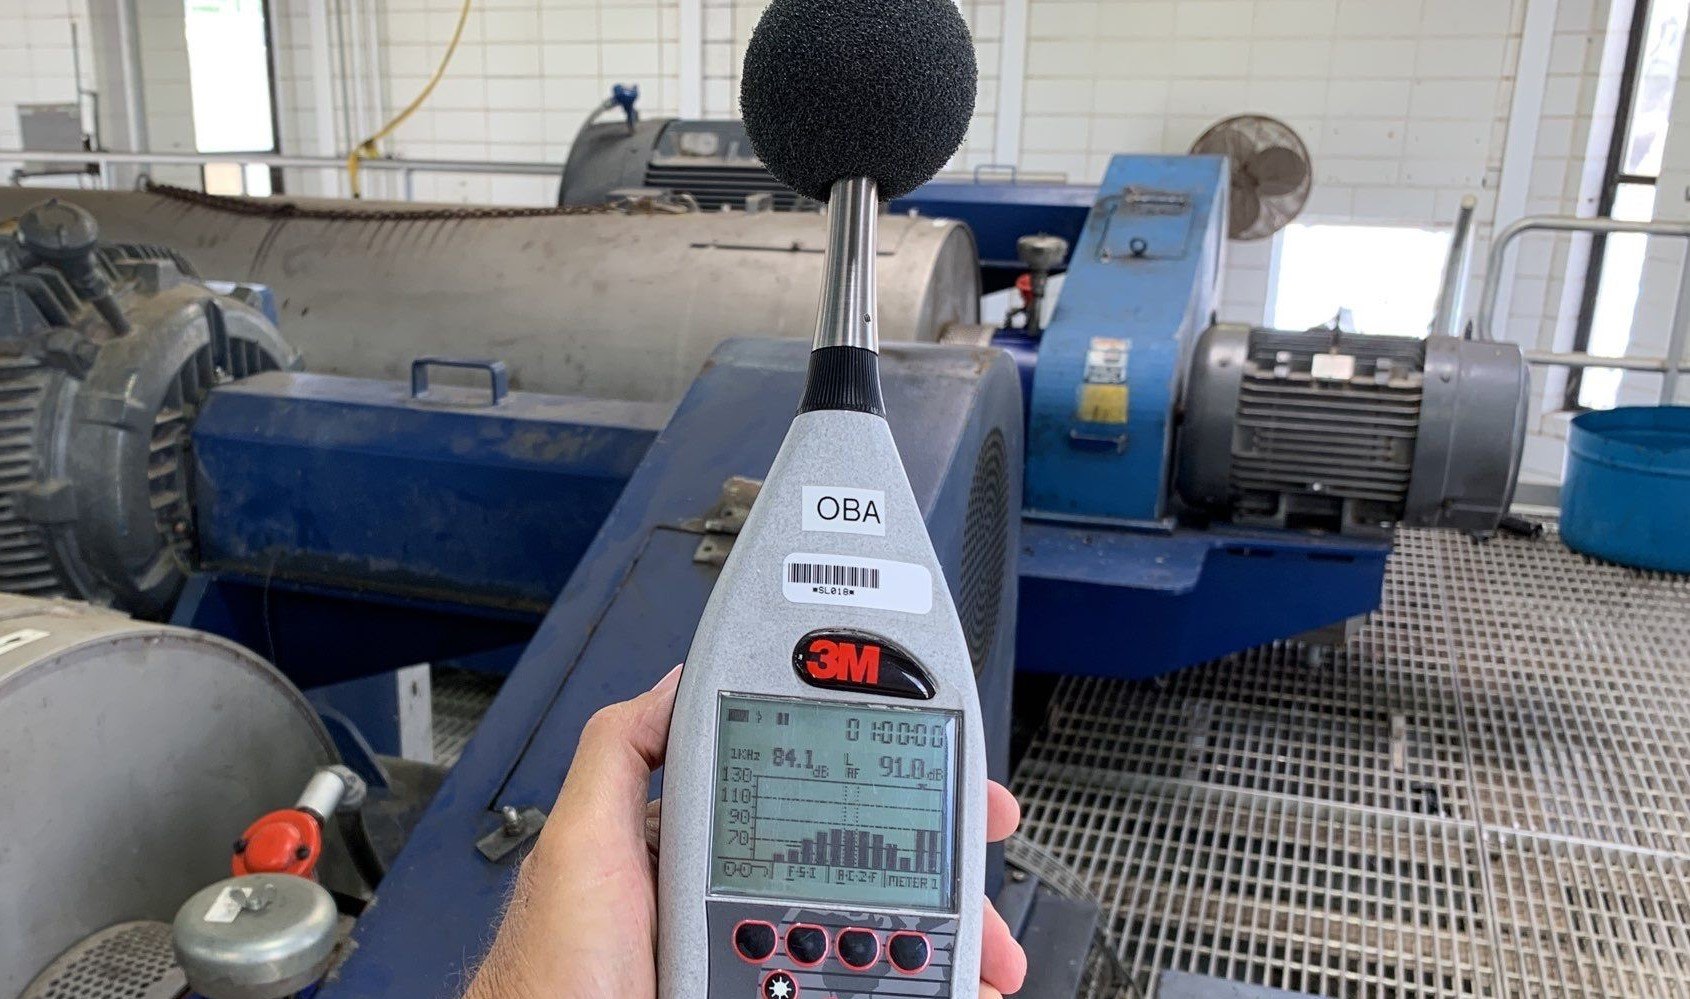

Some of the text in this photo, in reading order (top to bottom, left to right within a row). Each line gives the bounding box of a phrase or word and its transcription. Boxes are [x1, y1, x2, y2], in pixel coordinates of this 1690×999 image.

[817, 495, 881, 525] OBA
[806, 639, 880, 684] 3M
[772, 747, 814, 768] 84.1
[723, 766, 752, 782] 130
[879, 756, 925, 779] 91.0
[722, 788, 751, 803] 110
[730, 809, 750, 824] 90
[728, 831, 749, 845] 70
[888, 876, 939, 889] METER 1
